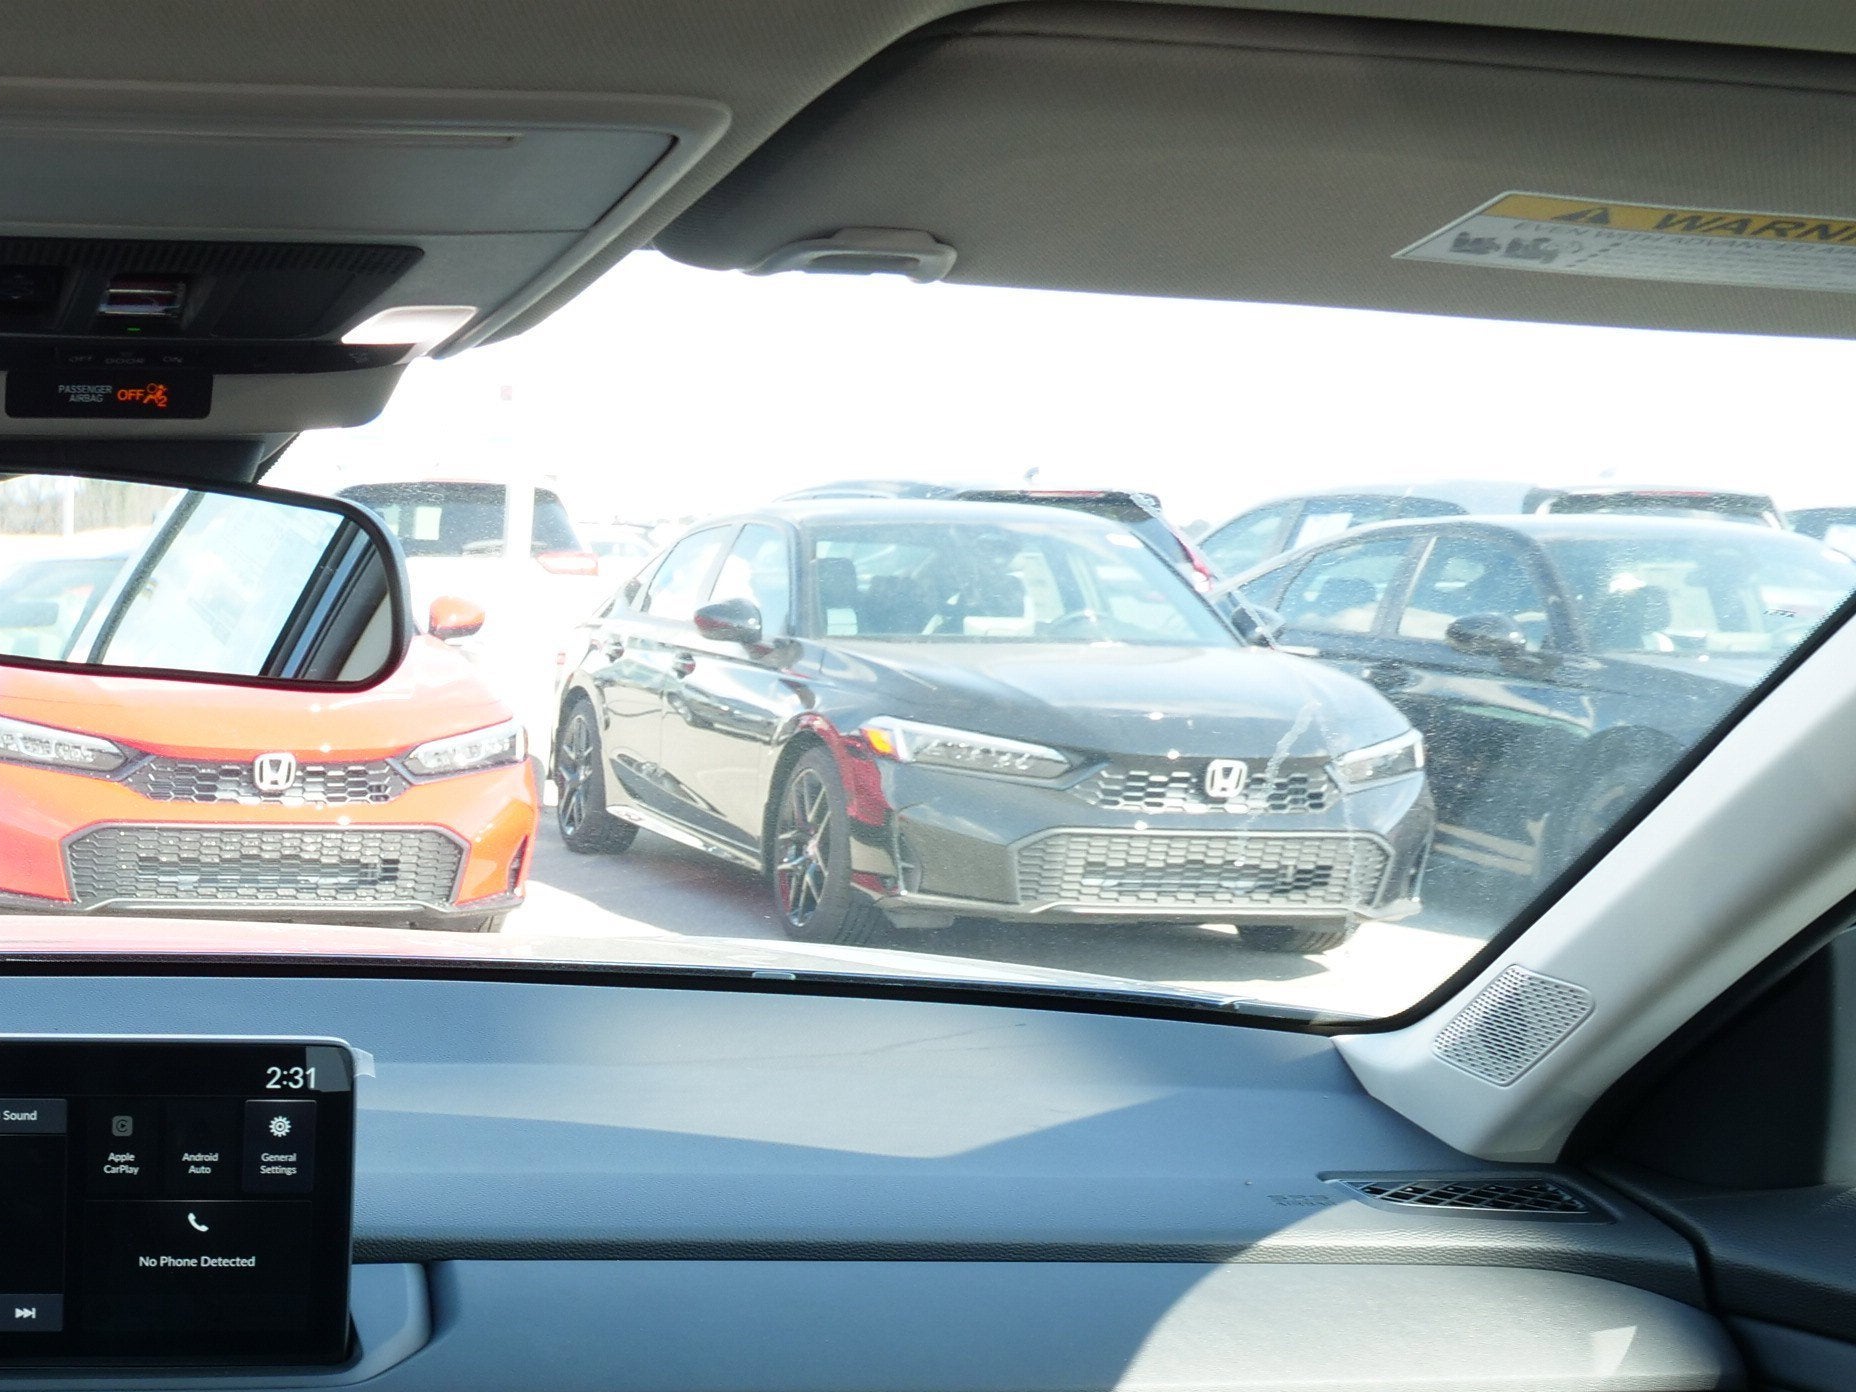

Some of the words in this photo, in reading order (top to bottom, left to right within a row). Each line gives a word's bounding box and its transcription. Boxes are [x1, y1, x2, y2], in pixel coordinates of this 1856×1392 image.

[58, 384, 113, 394] PASSENGER
[69, 394, 104, 403] AIRBAG
[116, 389, 145, 401] OFF
[265, 1066, 316, 1089] 2:31
[3, 1109, 38, 1121] Sound
[107, 1152, 135, 1163] Apple
[182, 1152, 219, 1162] Android
[261, 1152, 297, 1162] General
[103, 1165, 140, 1175] CarPlay
[188, 1165, 211, 1174] Auto
[259, 1165, 297, 1175] Settings
[139, 1256, 157, 1267] No
[160, 1256, 198, 1267] Phone
[200, 1256, 256, 1267] Detected
